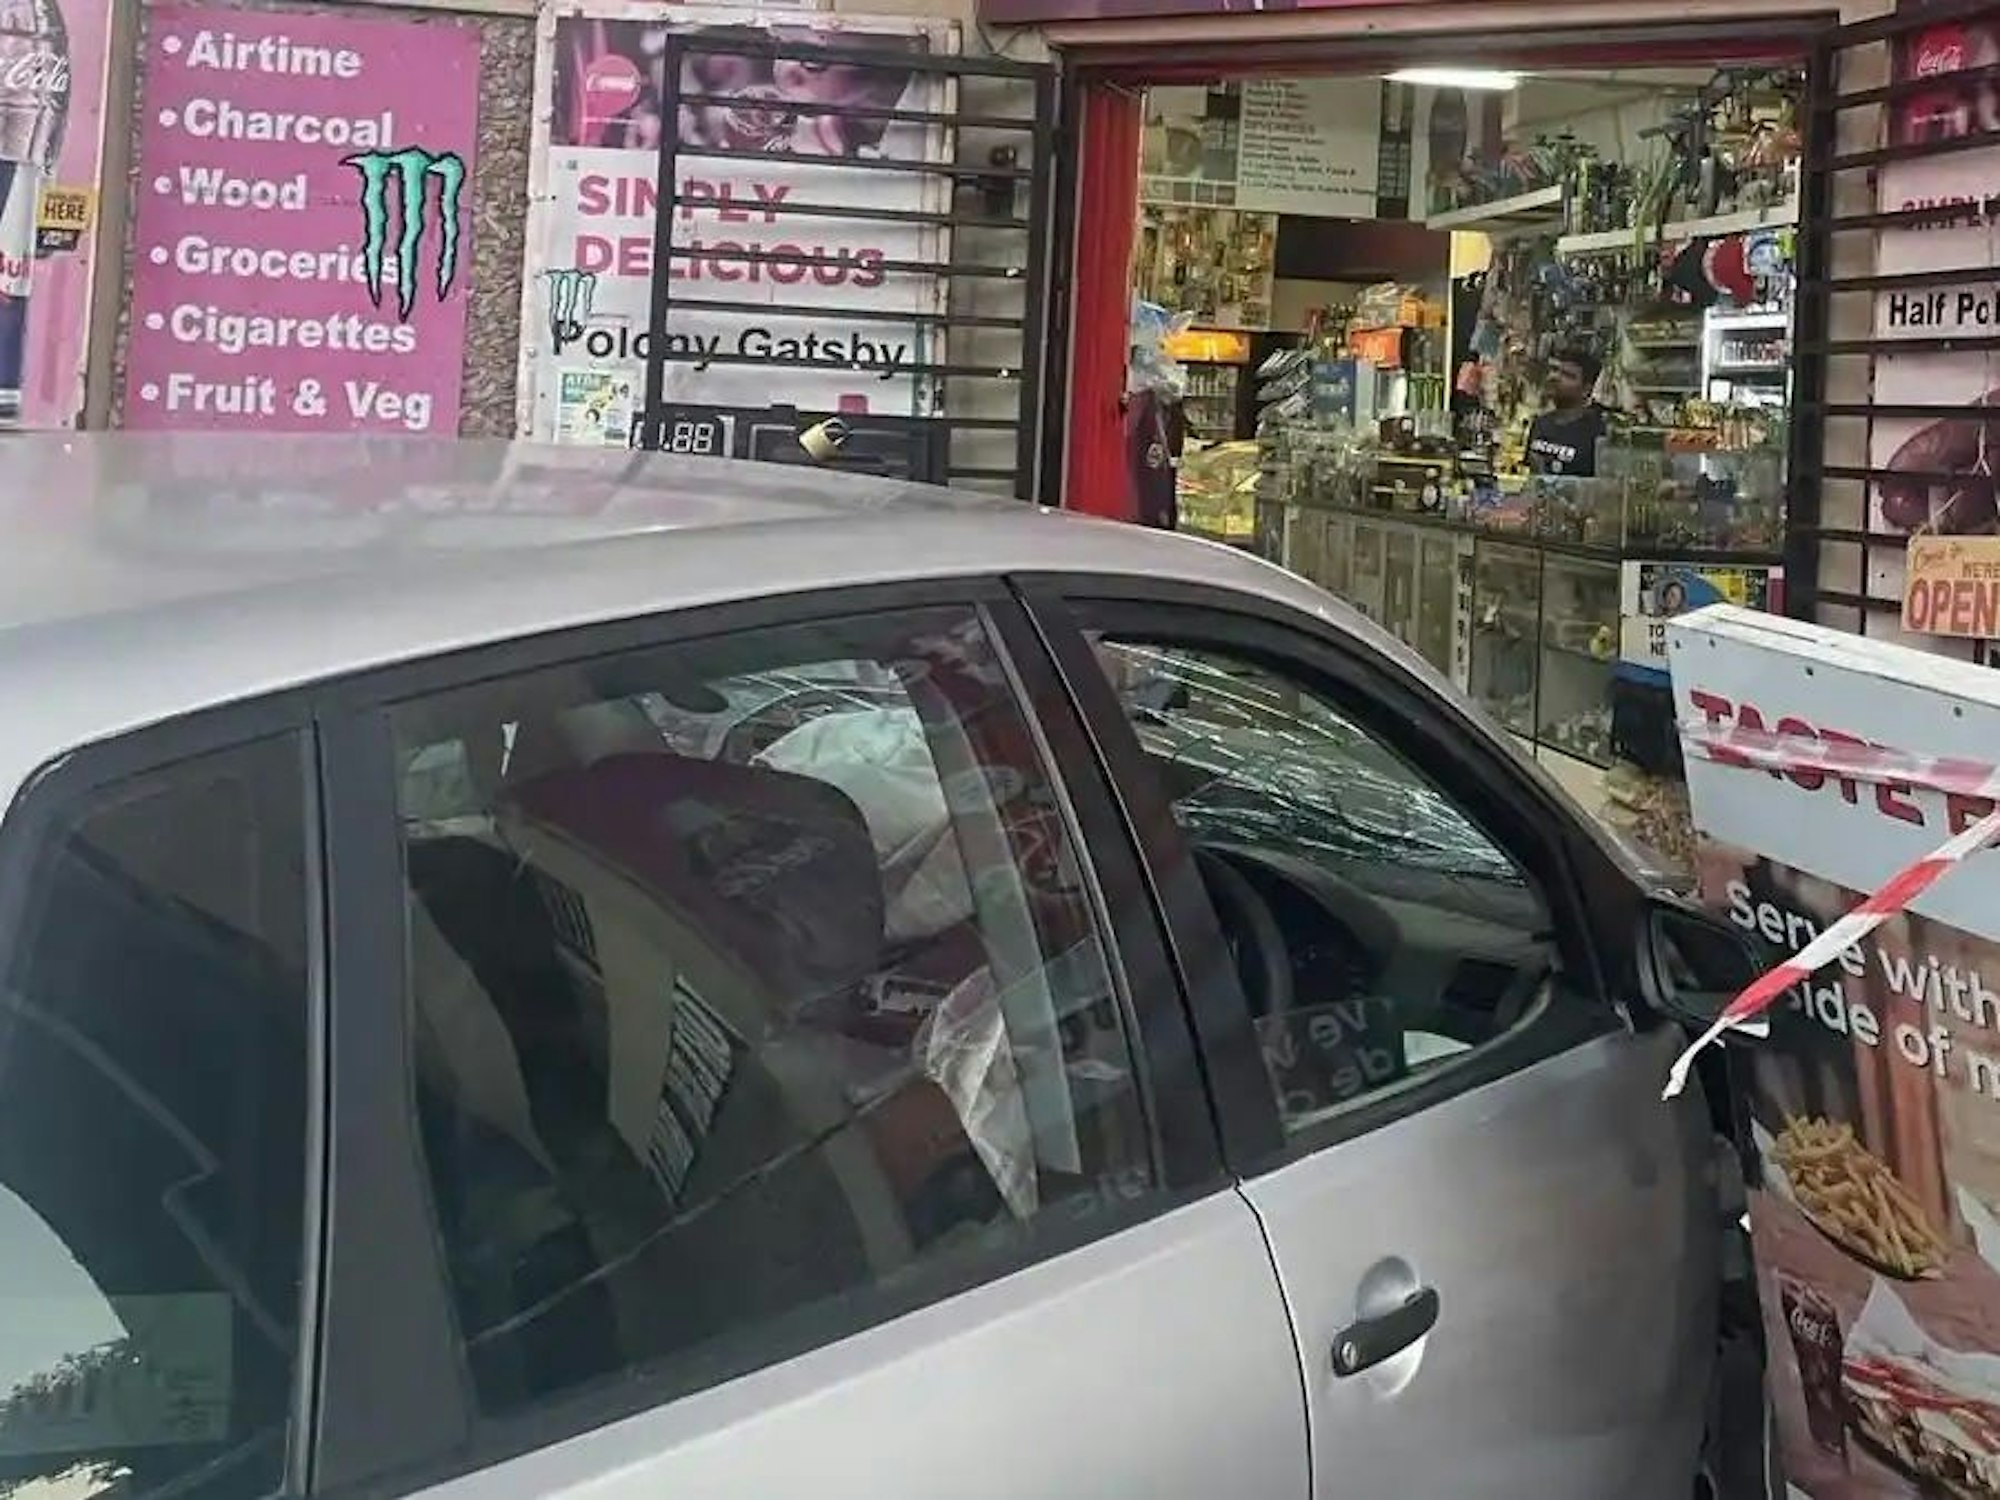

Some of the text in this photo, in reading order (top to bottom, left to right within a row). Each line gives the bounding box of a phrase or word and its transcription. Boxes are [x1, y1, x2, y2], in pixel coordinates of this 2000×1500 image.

[186, 29, 362, 78] Airtime
[183, 98, 394, 149] Charcoal
[44, 200, 86, 221] HERE
[179, 166, 307, 211] Wood
[574, 234, 886, 290] DEICIOUS
[170, 303, 417, 354] Cigarettes
[1889, 292, 1947, 326] Half
[737, 326, 906, 380] Gatsby
[166, 373, 432, 430] Fruit & Veg
[1908, 578, 1999, 635] OPEN
[1726, 878, 2000, 1029] Sere with
[1894, 1021, 1952, 1077] of
